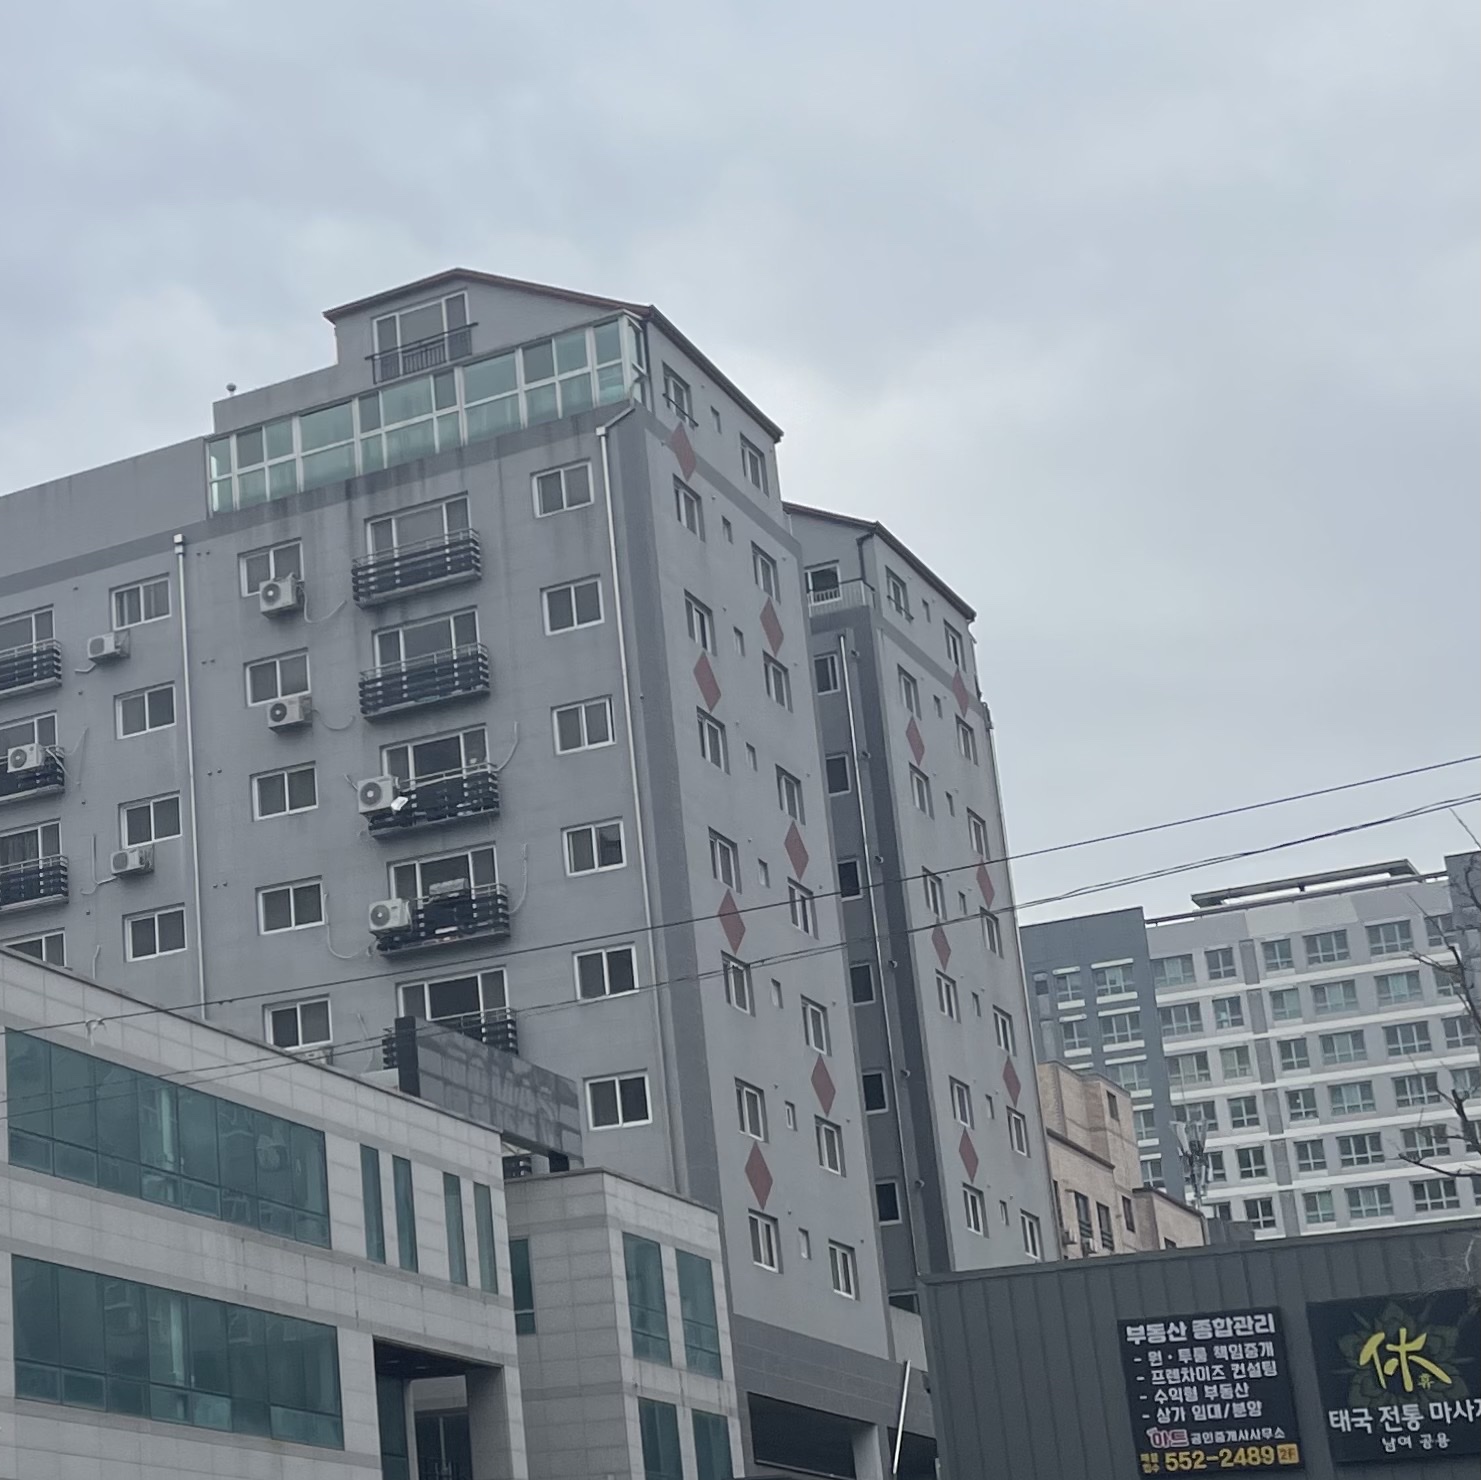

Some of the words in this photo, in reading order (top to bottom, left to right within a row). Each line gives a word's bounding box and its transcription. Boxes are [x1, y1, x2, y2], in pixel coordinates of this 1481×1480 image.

[1126, 1321, 1188, 1345] 부동산
[1192, 1313, 1275, 1340] 종합관리
[1213, 1341, 1275, 1361] 책임중개
[1359, 1327, 1452, 1392] 休
[1231, 1360, 1278, 1379] 컨설팅
[1154, 1385, 1199, 1404] 수익형
[1204, 1382, 1250, 1401] 부동산
[1156, 1406, 1186, 1424] 상가
[1328, 1408, 1373, 1434] 태국
[1378, 1403, 1424, 1432] 전통
[1190, 1427, 1285, 1445] 공인중개사사무소
[1382, 1435, 1412, 1453] 남여
[1420, 1432, 1451, 1449] 공용
[1165, 1445, 1275, 1471] 552-2489
